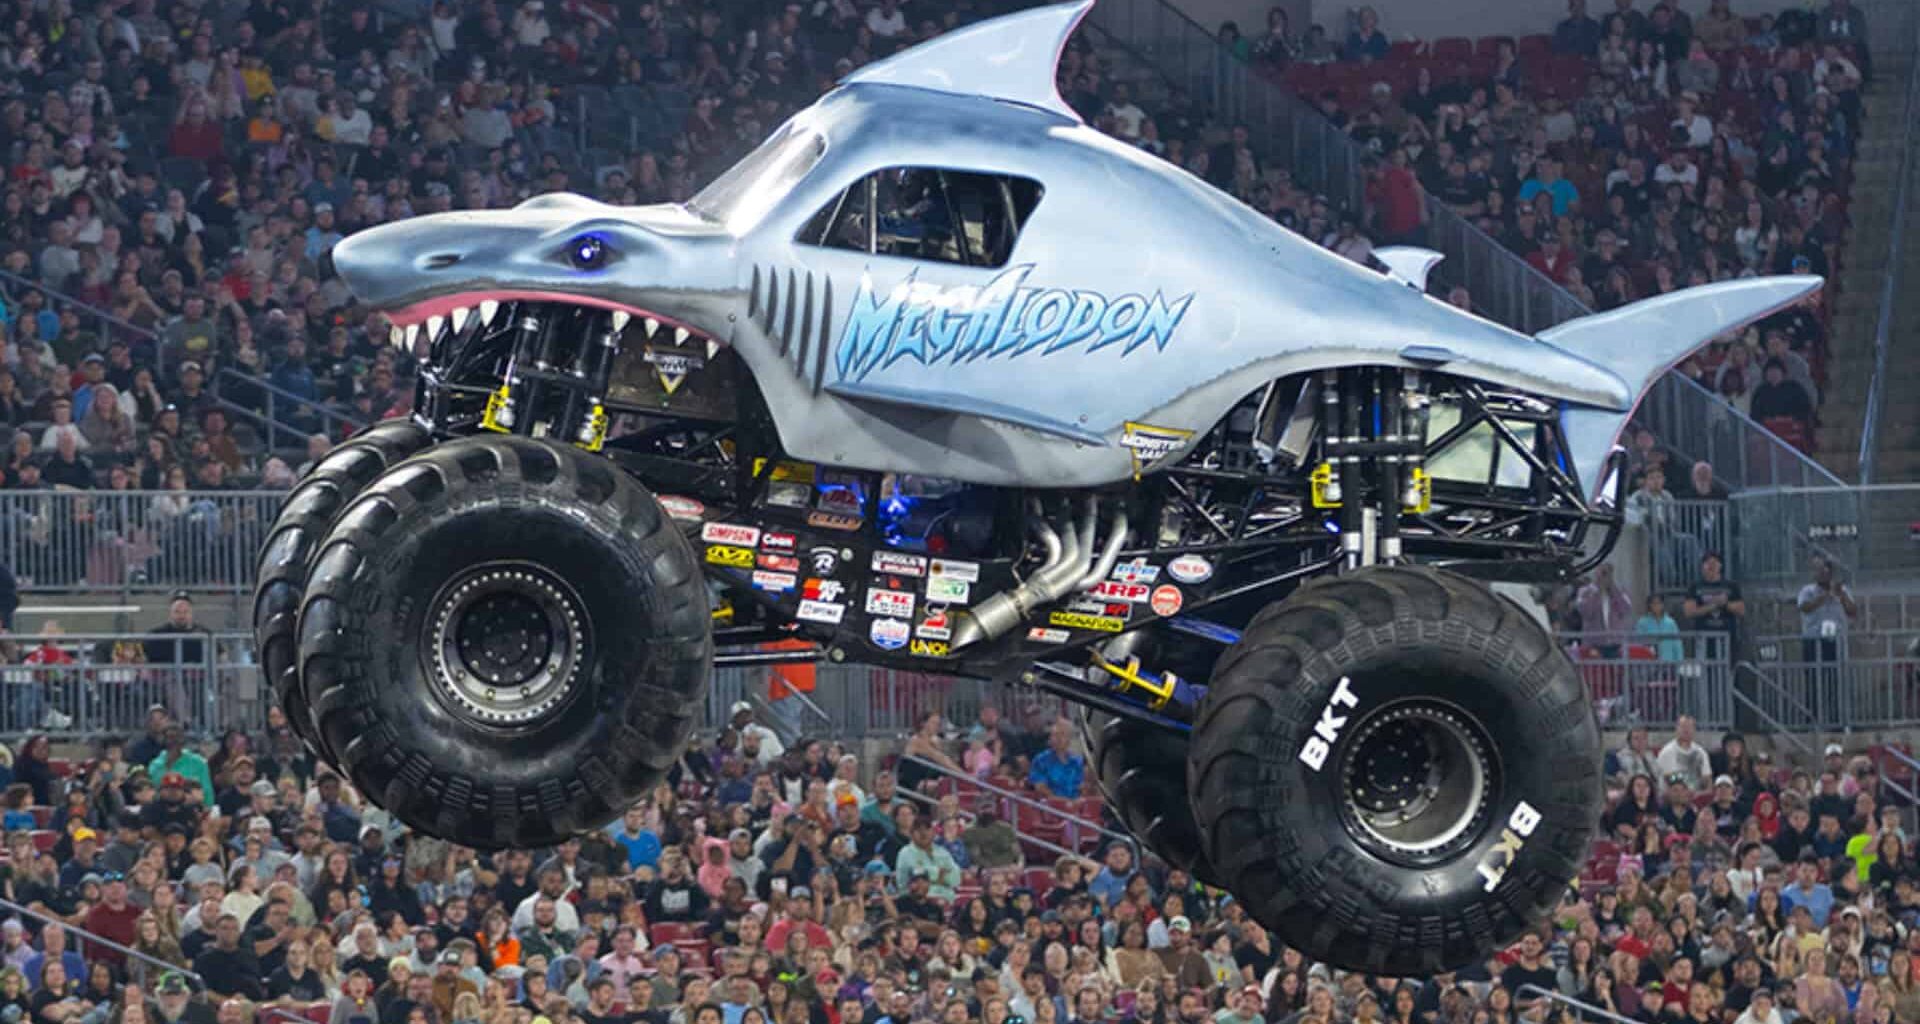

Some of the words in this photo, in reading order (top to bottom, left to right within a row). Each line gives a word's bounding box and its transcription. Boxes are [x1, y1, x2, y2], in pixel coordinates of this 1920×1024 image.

[836, 263, 1195, 382] MEGALODON
[706, 525, 755, 543] SIMPSON
[1087, 582, 1148, 598] ARP
[1298, 675, 1360, 771] BKT
[1476, 800, 1543, 893] BKT
